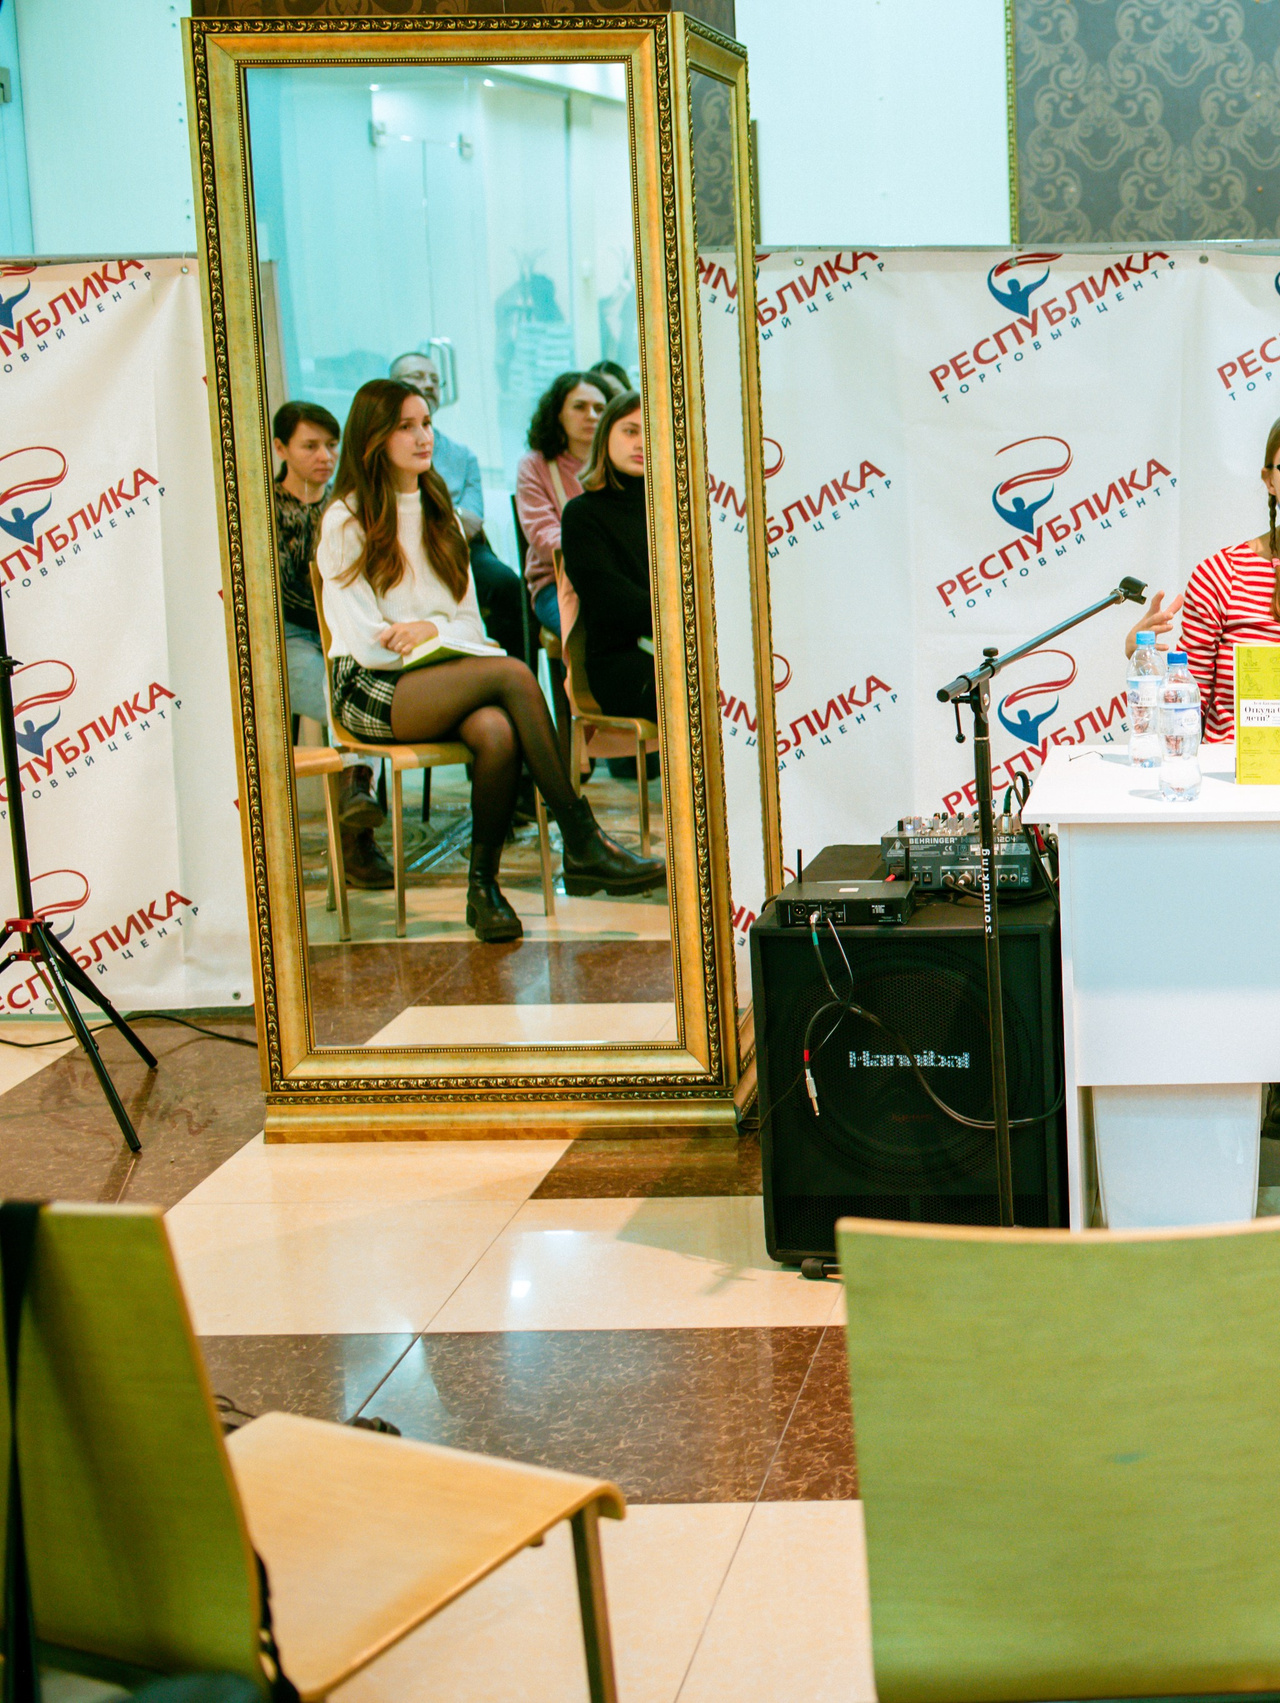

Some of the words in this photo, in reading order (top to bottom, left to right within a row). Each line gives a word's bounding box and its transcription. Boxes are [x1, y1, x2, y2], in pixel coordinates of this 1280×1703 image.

[79, 270, 151, 325] ЦЕНТР
[807, 261, 886, 314] ЦЕНТР
[929, 252, 1170, 392] РЕСПУБЛИКА
[942, 317, 1081, 404] ТОРГОВЫЙ
[1096, 260, 1175, 314] ЦЕНТР
[0, 468, 159, 588] ПУБЛИКА
[93, 486, 167, 540] ЦЕНТР
[813, 478, 892, 533] ЦЕНТР
[937, 458, 1172, 606] РЕСПУБЛИКА
[948, 533, 1086, 619] ТОРГОВЫЙ
[1100, 477, 1178, 530] ЦЕНТР
[107, 699, 182, 753] ЦЕНТР
[818, 692, 899, 747] ЦЕНТР
[981, 848, 992, 934] soundking
[121, 906, 200, 961] ЦЕНТР
